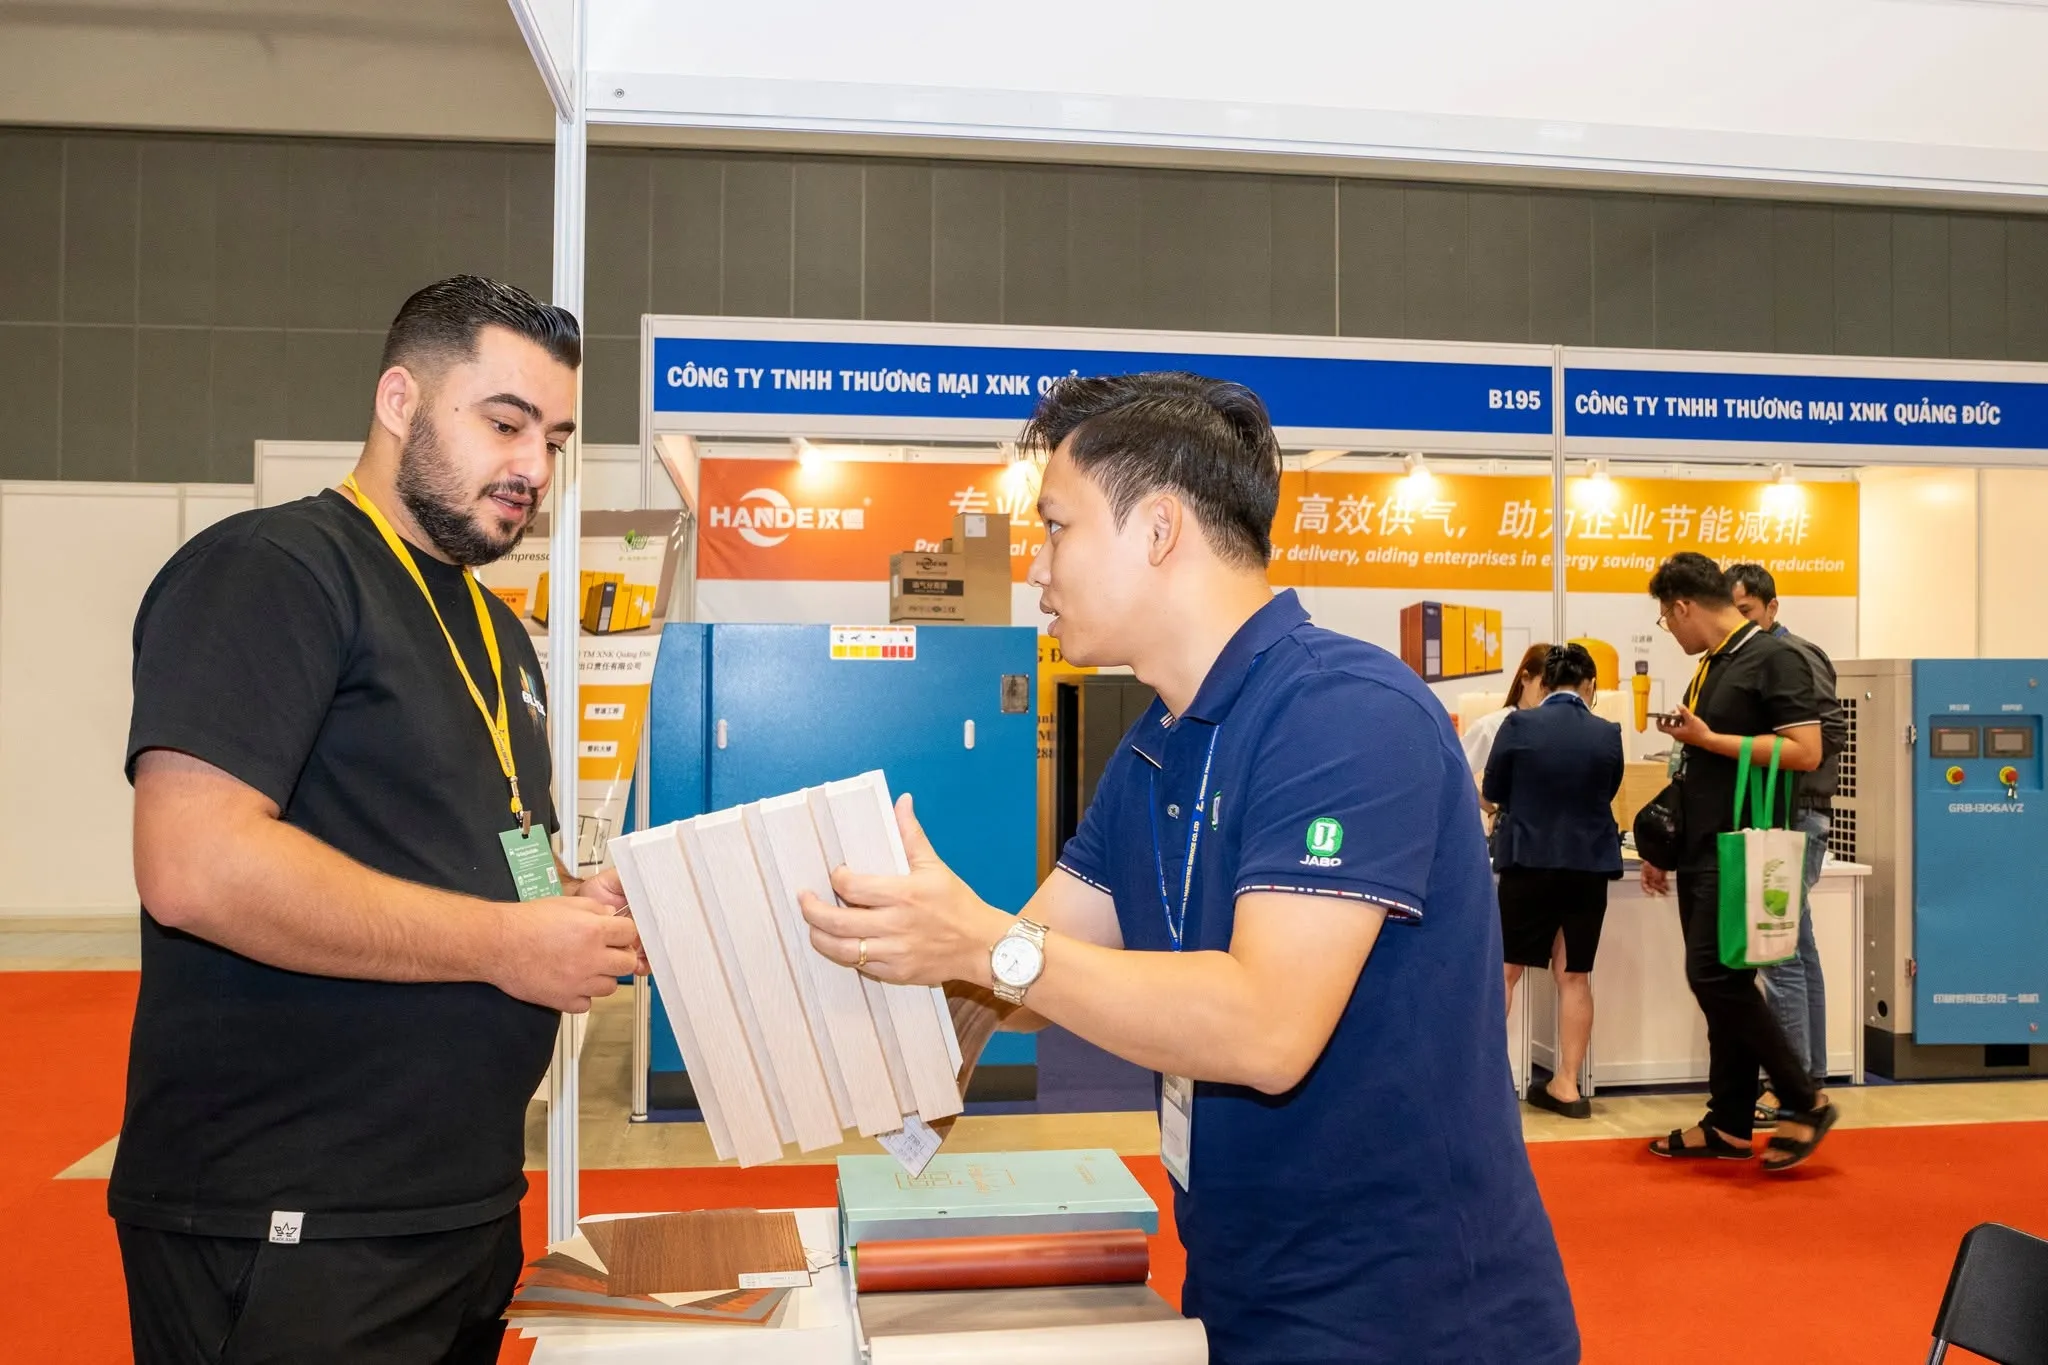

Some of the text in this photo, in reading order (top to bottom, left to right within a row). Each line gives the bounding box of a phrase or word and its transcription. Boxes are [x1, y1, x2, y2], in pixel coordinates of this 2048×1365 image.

[667, 361, 728, 389] CÔNG
[734, 368, 764, 389] TY
[771, 369, 832, 391] TNHH
[840, 368, 931, 394] THƯƠNG
[938, 373, 978, 398] MẠI
[985, 374, 1031, 396] XNK
[1488, 389, 1541, 410] B195
[1575, 390, 2001, 426] CÔNG TY TNHH THƯƠNG MẠI XNK QUẢNG ĐỨC
[709, 506, 814, 530] HANDE
[1287, 544, 1360, 565] delivery,
[1365, 545, 1418, 567] aiding
[1424, 546, 1517, 568] enterprises
[1521, 548, 1537, 566] in
[1541, 552, 1600, 572] eergy
[1602, 553, 1655, 573] saving
[1769, 555, 1845, 573] reduction
[1299, 854, 1342, 868] JABO
